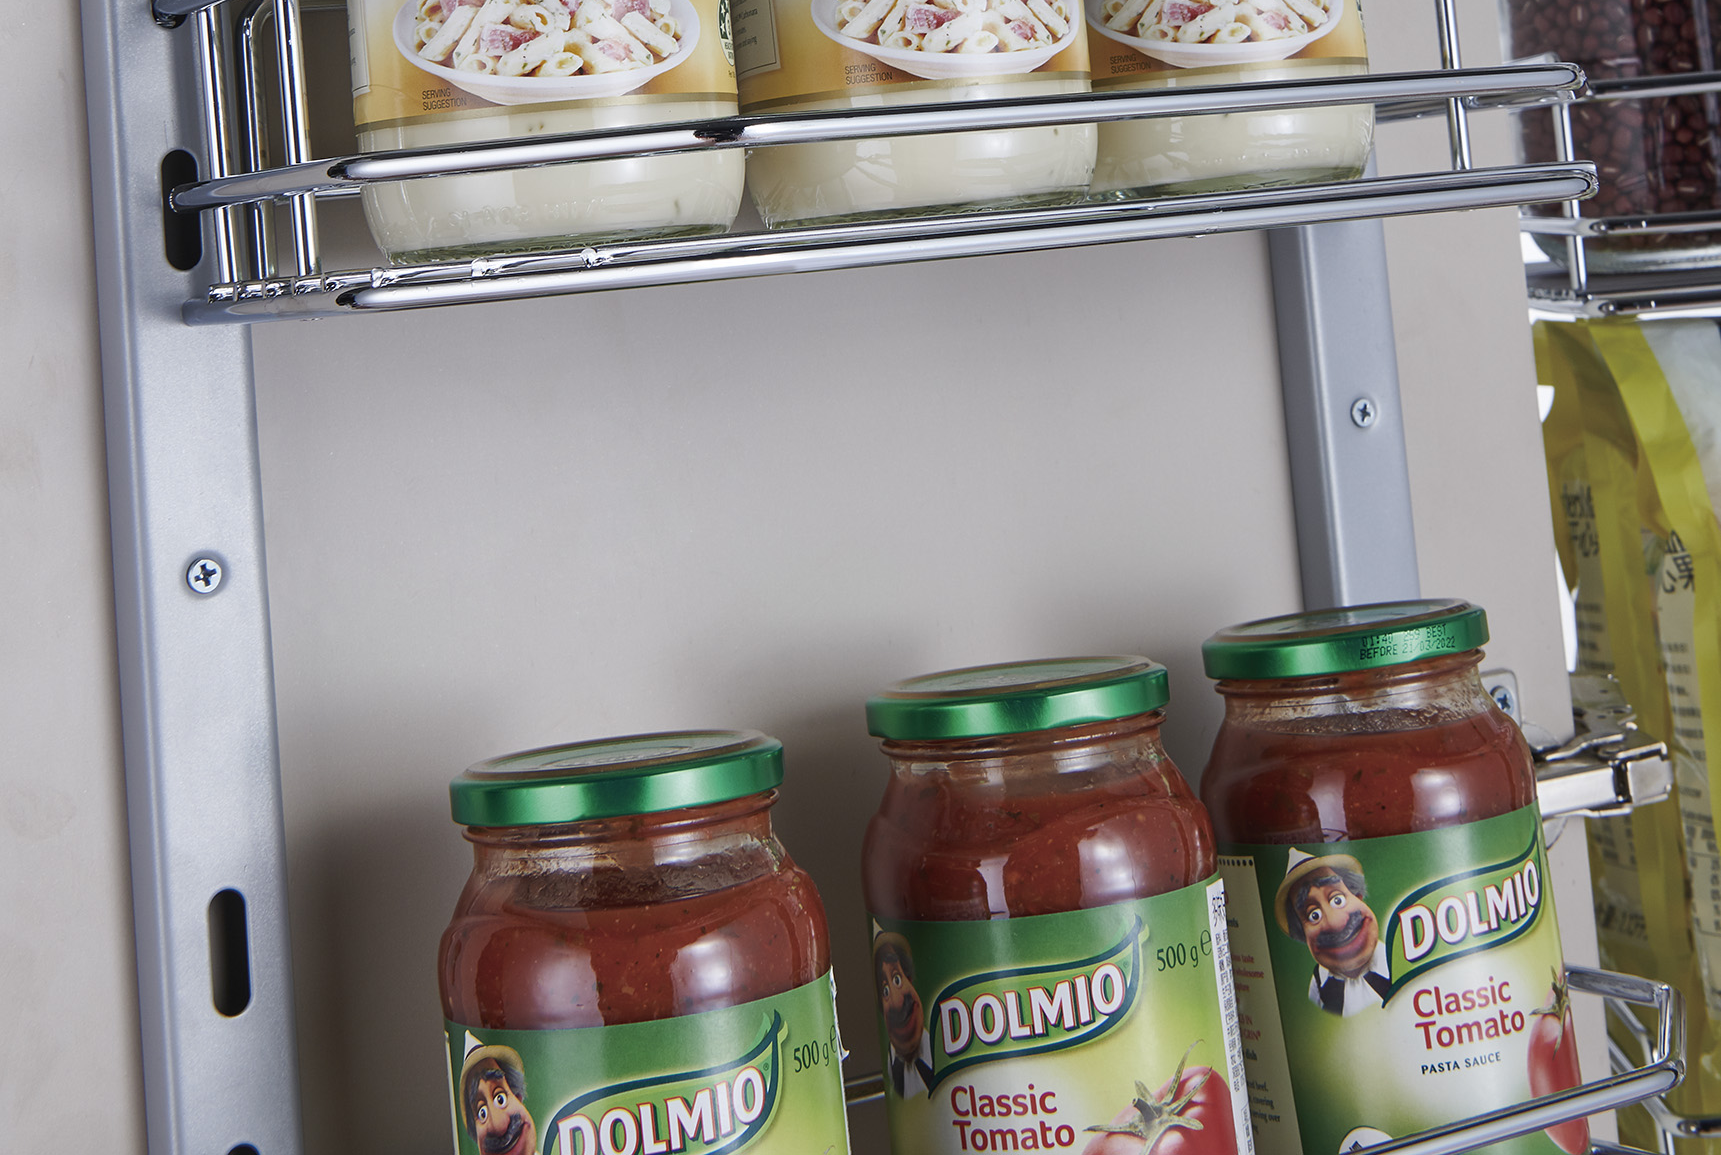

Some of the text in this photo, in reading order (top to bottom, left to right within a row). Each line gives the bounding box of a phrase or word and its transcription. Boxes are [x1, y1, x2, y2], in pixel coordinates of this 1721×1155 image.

[845, 63, 876, 75] SERVING
[845, 72, 893, 85] SUGGESTION
[422, 88, 452, 100] SERVING
[422, 98, 468, 111] SUGGESTION
[1426, 623, 1447, 638] BEST
[1360, 636, 1456, 660] BEFORE 21/03/2022
[1397, 859, 1541, 962] DOLMIO
[1156, 942, 1186, 972] 500
[938, 962, 1126, 1057] DOLMIO
[1413, 975, 1512, 1018] Classic
[1415, 1009, 1525, 1050] Tomato
[793, 1040, 820, 1073] 500
[1421, 1051, 1502, 1075] PASTA SAUCE
[557, 1065, 766, 1155] DOLMIO
[951, 1084, 1058, 1118] Classic
[952, 1118, 1076, 1152] Tomato
